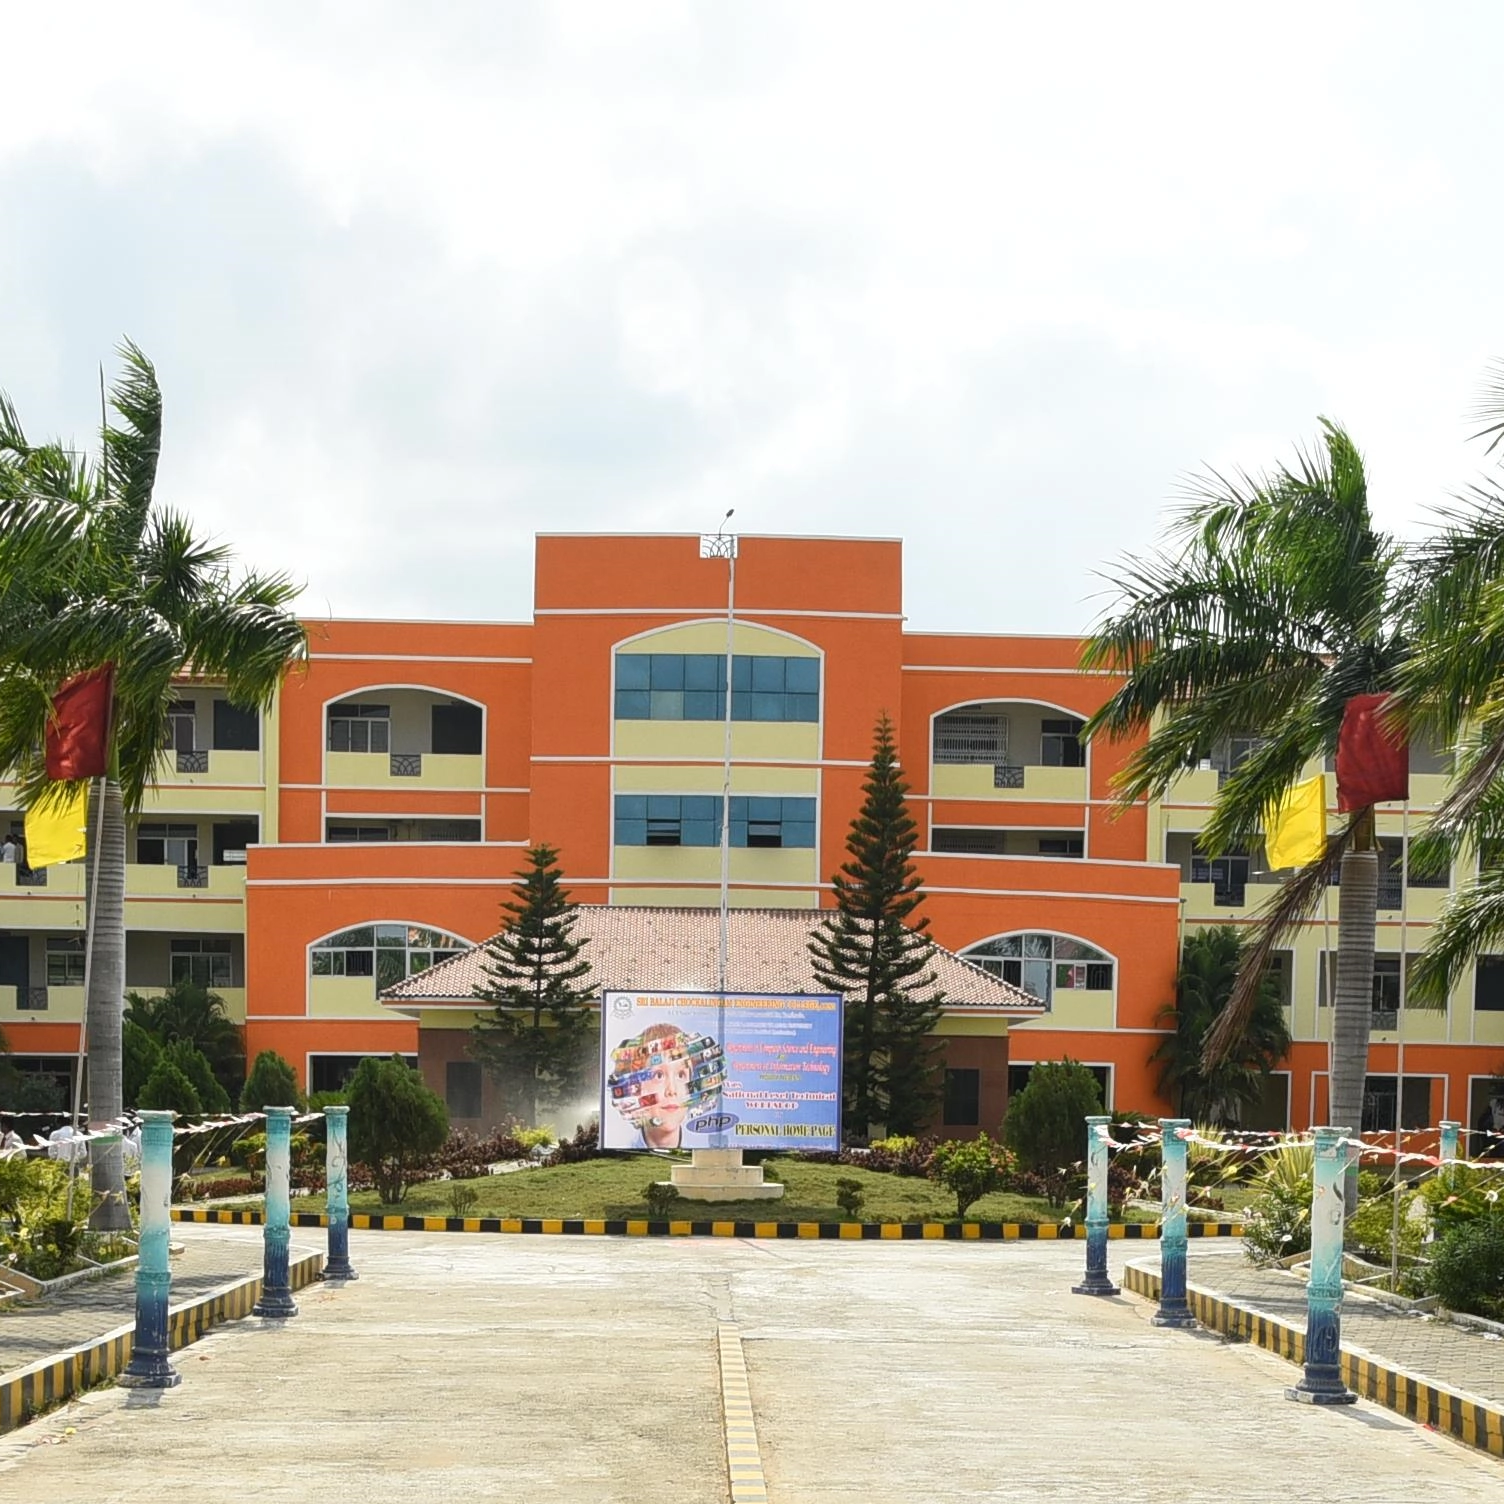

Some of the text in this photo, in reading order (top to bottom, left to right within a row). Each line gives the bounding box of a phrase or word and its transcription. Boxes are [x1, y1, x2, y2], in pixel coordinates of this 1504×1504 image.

[695, 1114, 731, 1131] php
[735, 1124, 835, 1136] PERSONAL HOME PAGE
